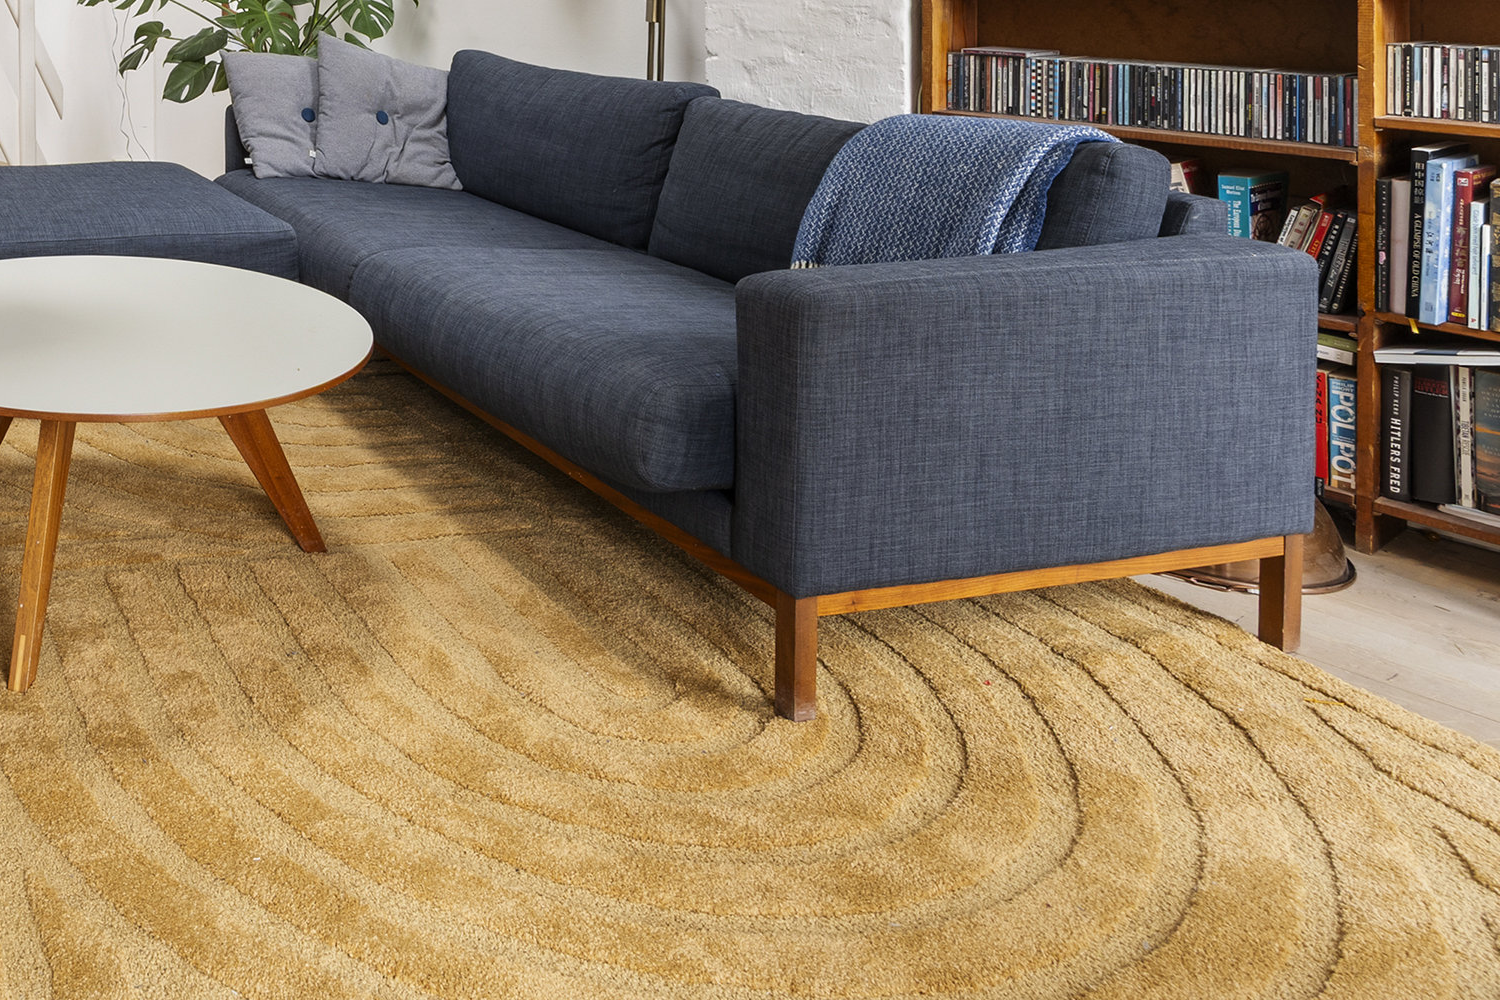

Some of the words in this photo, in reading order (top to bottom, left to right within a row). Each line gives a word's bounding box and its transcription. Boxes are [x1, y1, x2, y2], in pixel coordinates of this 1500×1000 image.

[1413, 250, 1419, 259] OF
[1411, 276, 1419, 297] CHINA
[1331, 390, 1356, 435] POL
[1390, 417, 1401, 463] HITLERS
[1461, 420, 1470, 438] TIBETAN
[1331, 440, 1356, 489] POT
[1390, 466, 1401, 494] FRED
